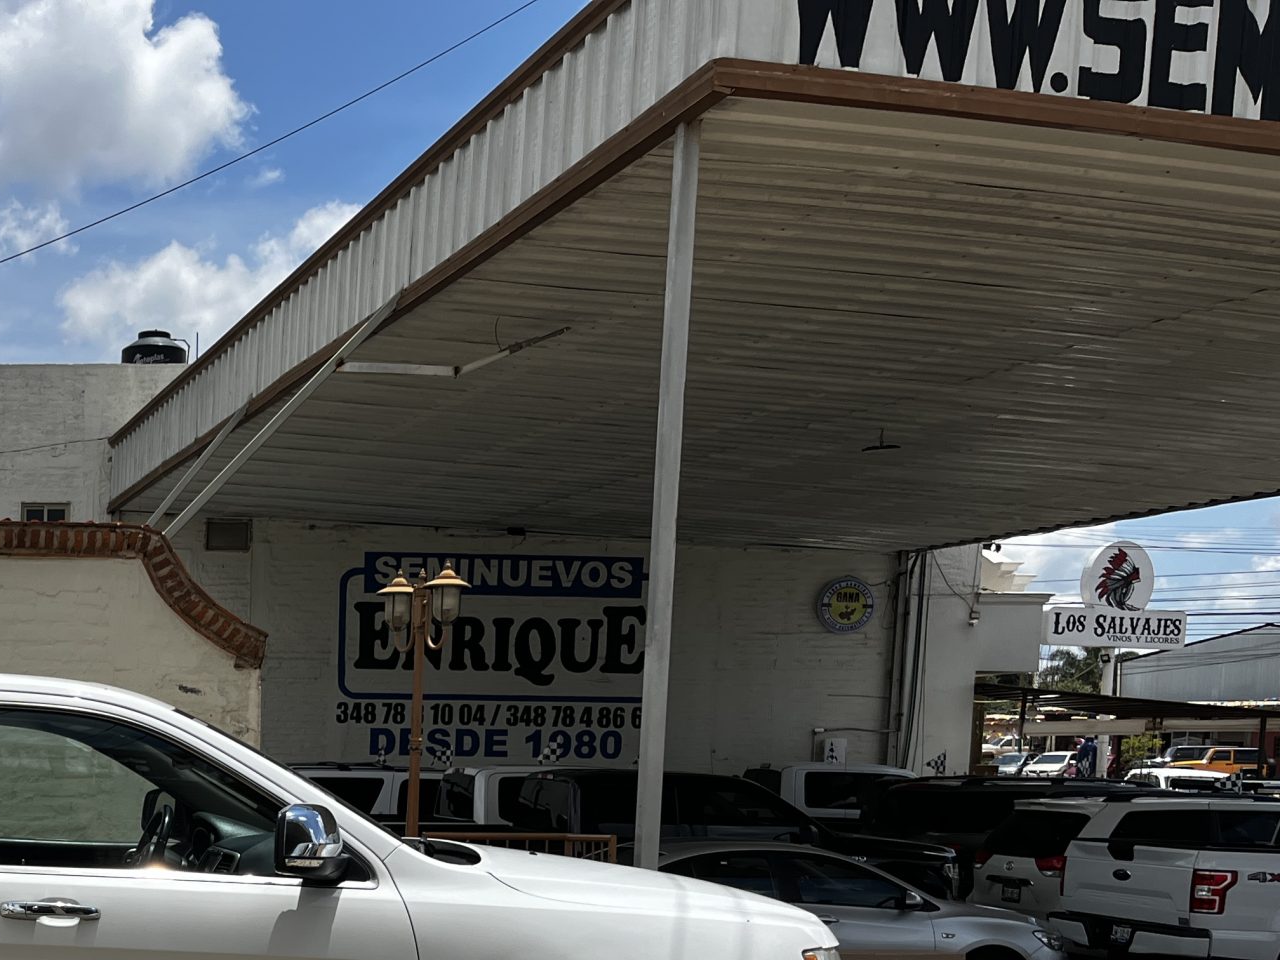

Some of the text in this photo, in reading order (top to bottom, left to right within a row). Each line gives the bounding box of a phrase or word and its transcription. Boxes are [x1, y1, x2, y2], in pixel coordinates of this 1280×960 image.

[374, 556, 633, 588] SEMINUEVOS
[1053, 612, 1182, 638] LOS SALVAJES
[1106, 634, 1180, 645] VINOS Y LICORES
[353, 601, 646, 686] ENRIQUE
[335, 701, 377, 724] 348
[382, 702, 406, 725] 78
[430, 703, 454, 725] 10
[458, 703, 486, 726] 04
[490, 704, 502, 726] /
[506, 705, 547, 727] 348
[551, 705, 575, 728] 78
[579, 706, 594, 728] 4
[597, 706, 626, 729] 86
[369, 727, 623, 760] DESDE 1980
